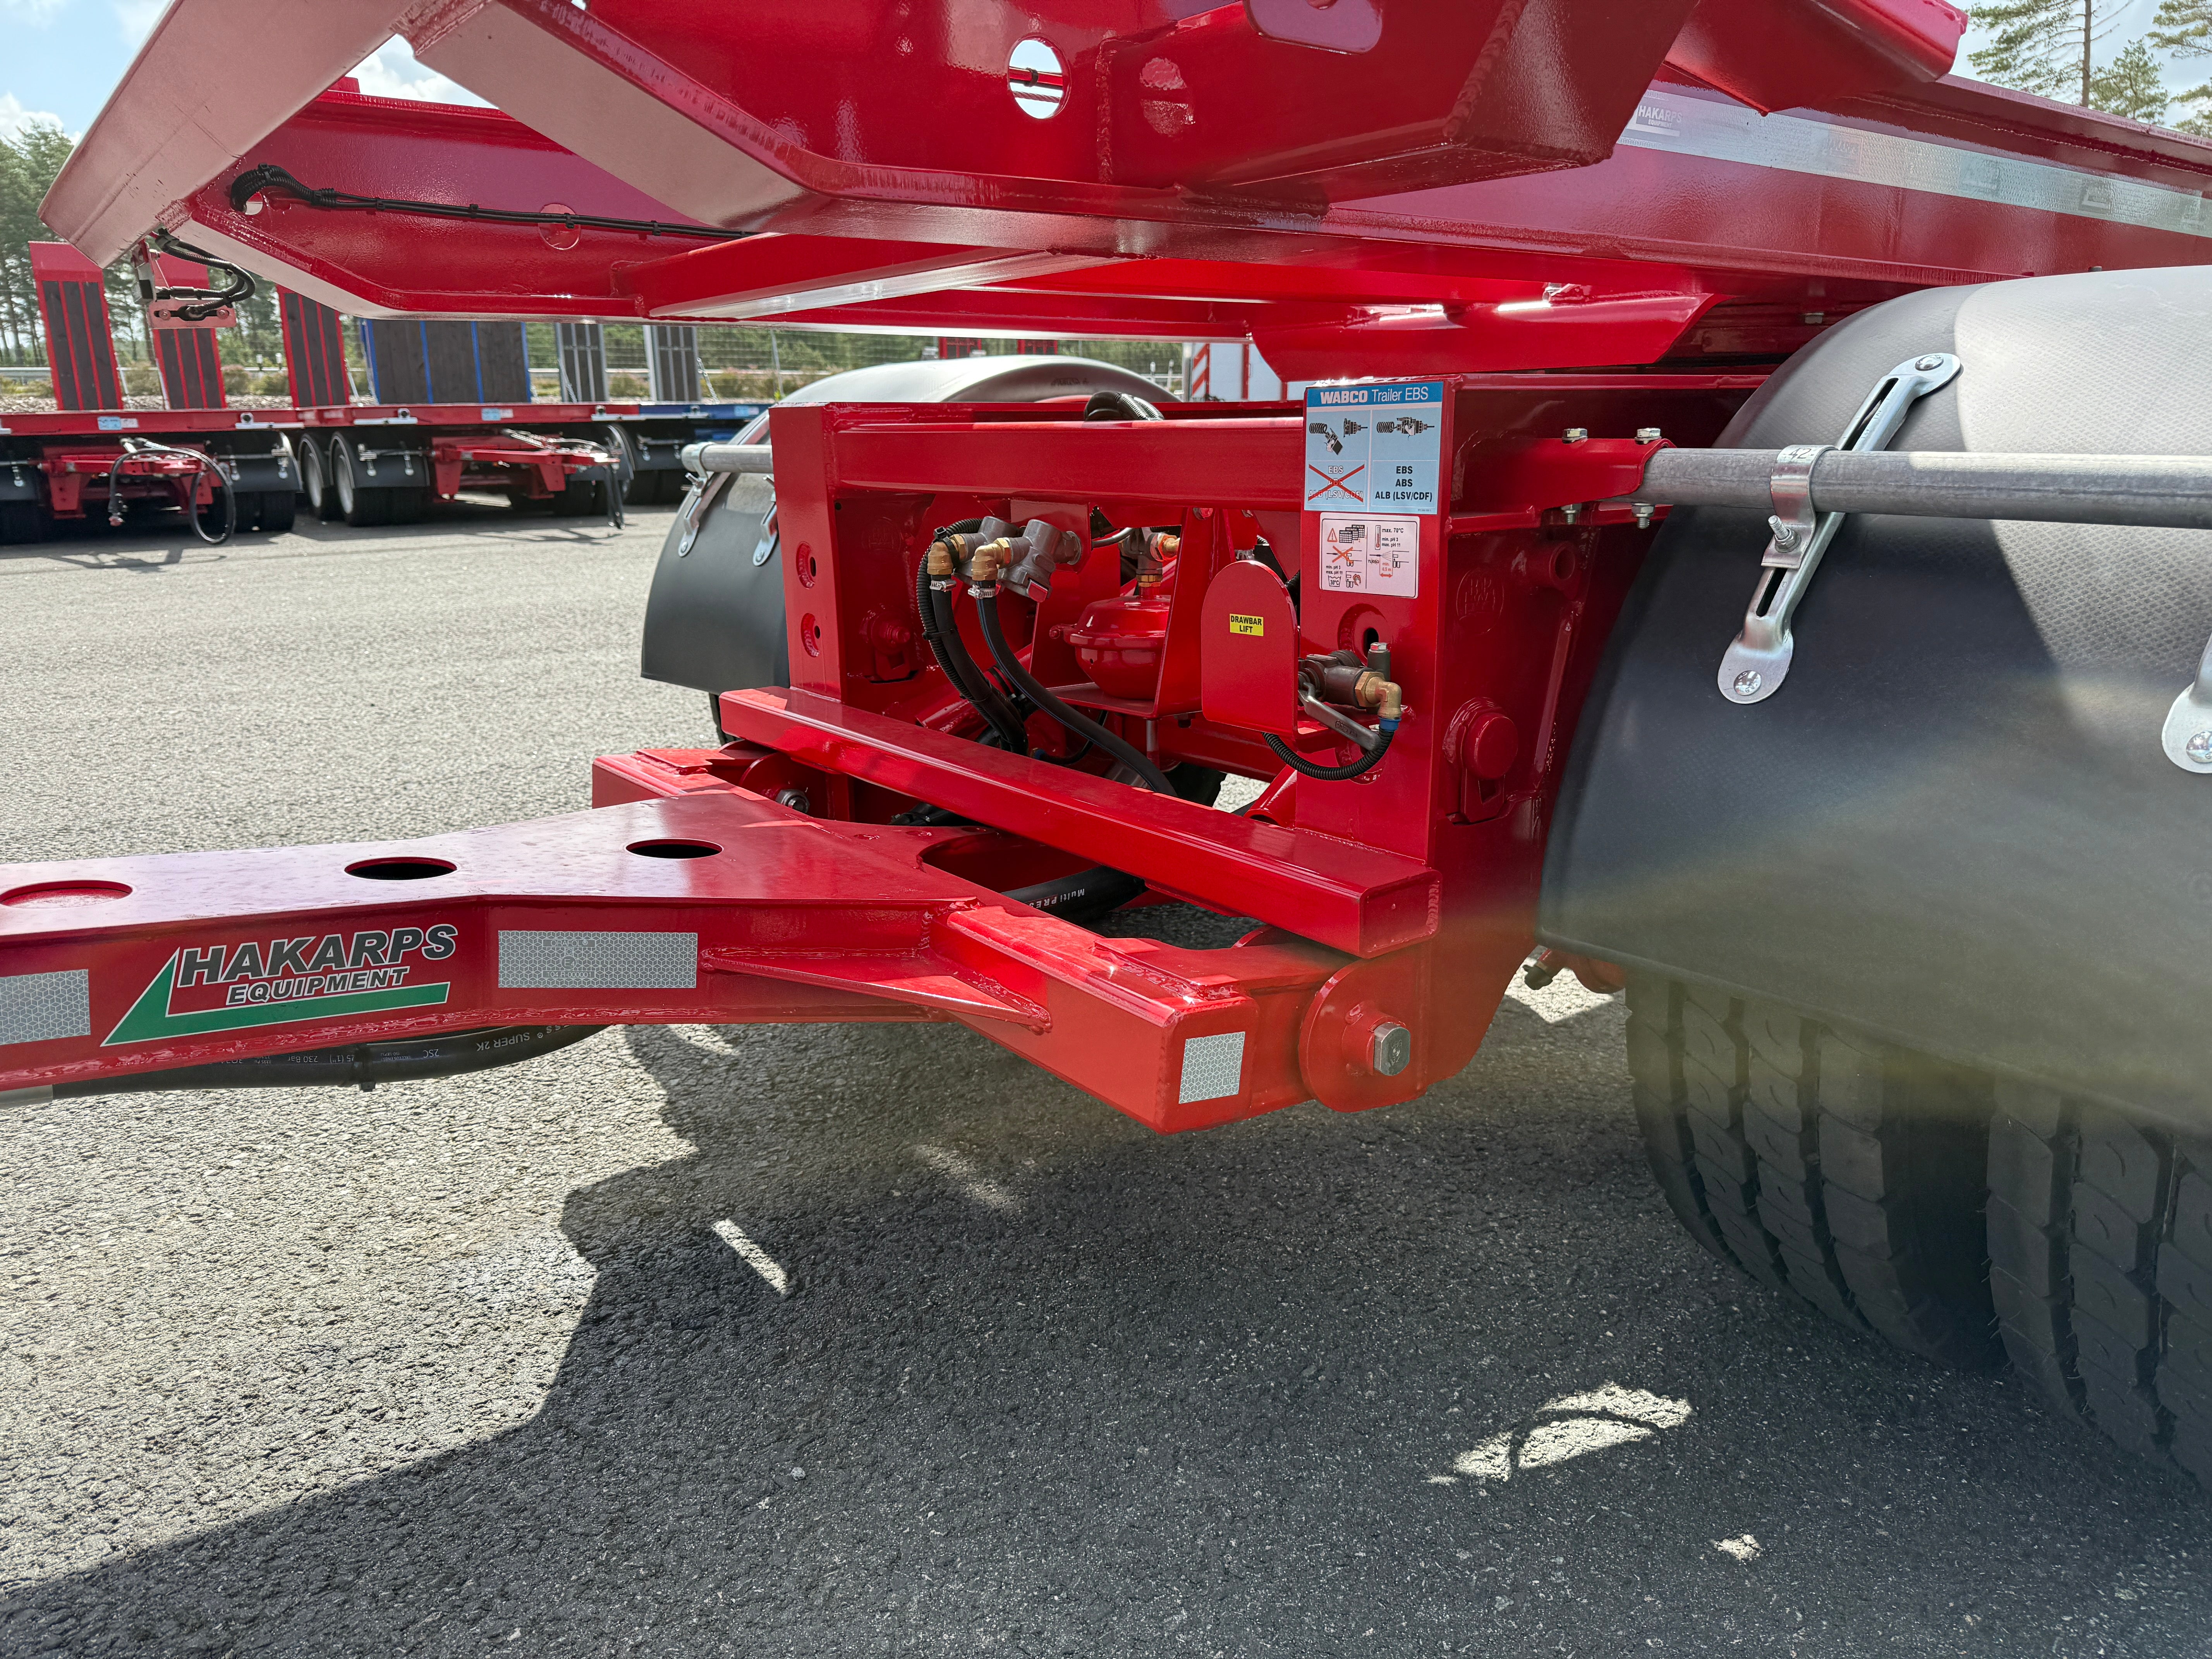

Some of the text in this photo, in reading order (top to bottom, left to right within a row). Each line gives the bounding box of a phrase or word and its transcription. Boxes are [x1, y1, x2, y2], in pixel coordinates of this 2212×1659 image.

[1638, 105, 1683, 124] HAKARPS
[1320, 386, 1428, 404] WABCO Trailer EBS
[1328, 465, 1344, 474] EBS
[1396, 466, 1413, 474] EBS
[1395, 479, 1413, 487] ABS
[1393, 491, 1432, 502] (LSV/CDF)
[1231, 615, 1262, 625] DRAWBAR
[1239, 625, 1253, 633] LIFT
[177, 924, 458, 988] HAKARPS
[226, 966, 410, 1005] EQUIPMENT
[493, 1032, 530, 1049] SUPER
[476, 1042, 490, 1052] 2K
[423, 1049, 440, 1058] 2SC
